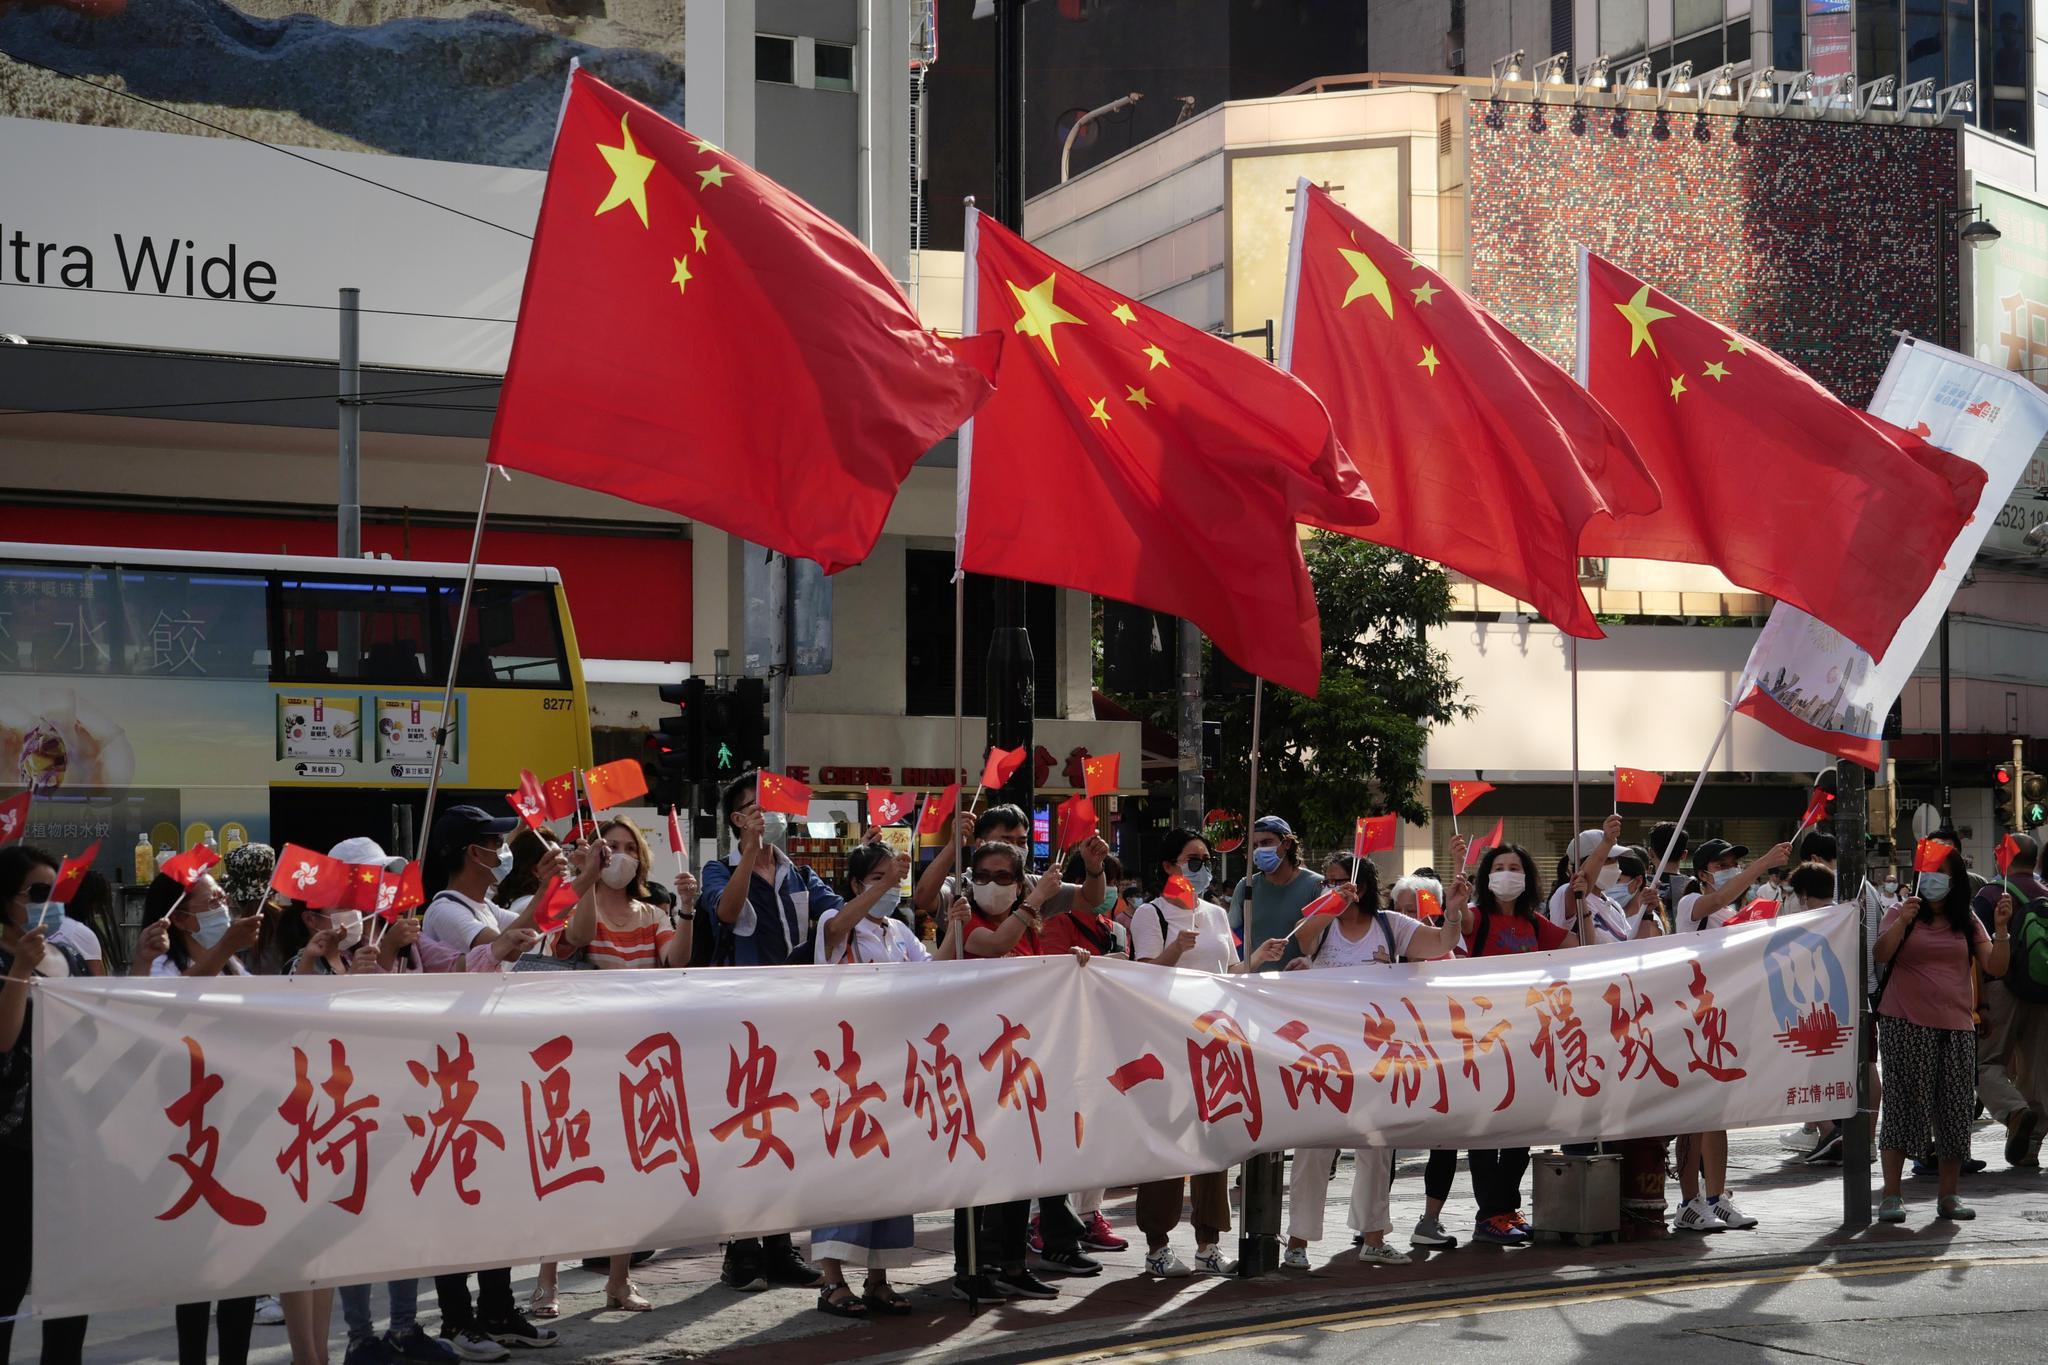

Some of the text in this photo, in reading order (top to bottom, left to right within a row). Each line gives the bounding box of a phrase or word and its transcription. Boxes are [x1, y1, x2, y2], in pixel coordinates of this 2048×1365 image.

[114, 234, 277, 302] Wide
[543, 697, 573, 711] 8277
[818, 766, 893, 786] CHENG
